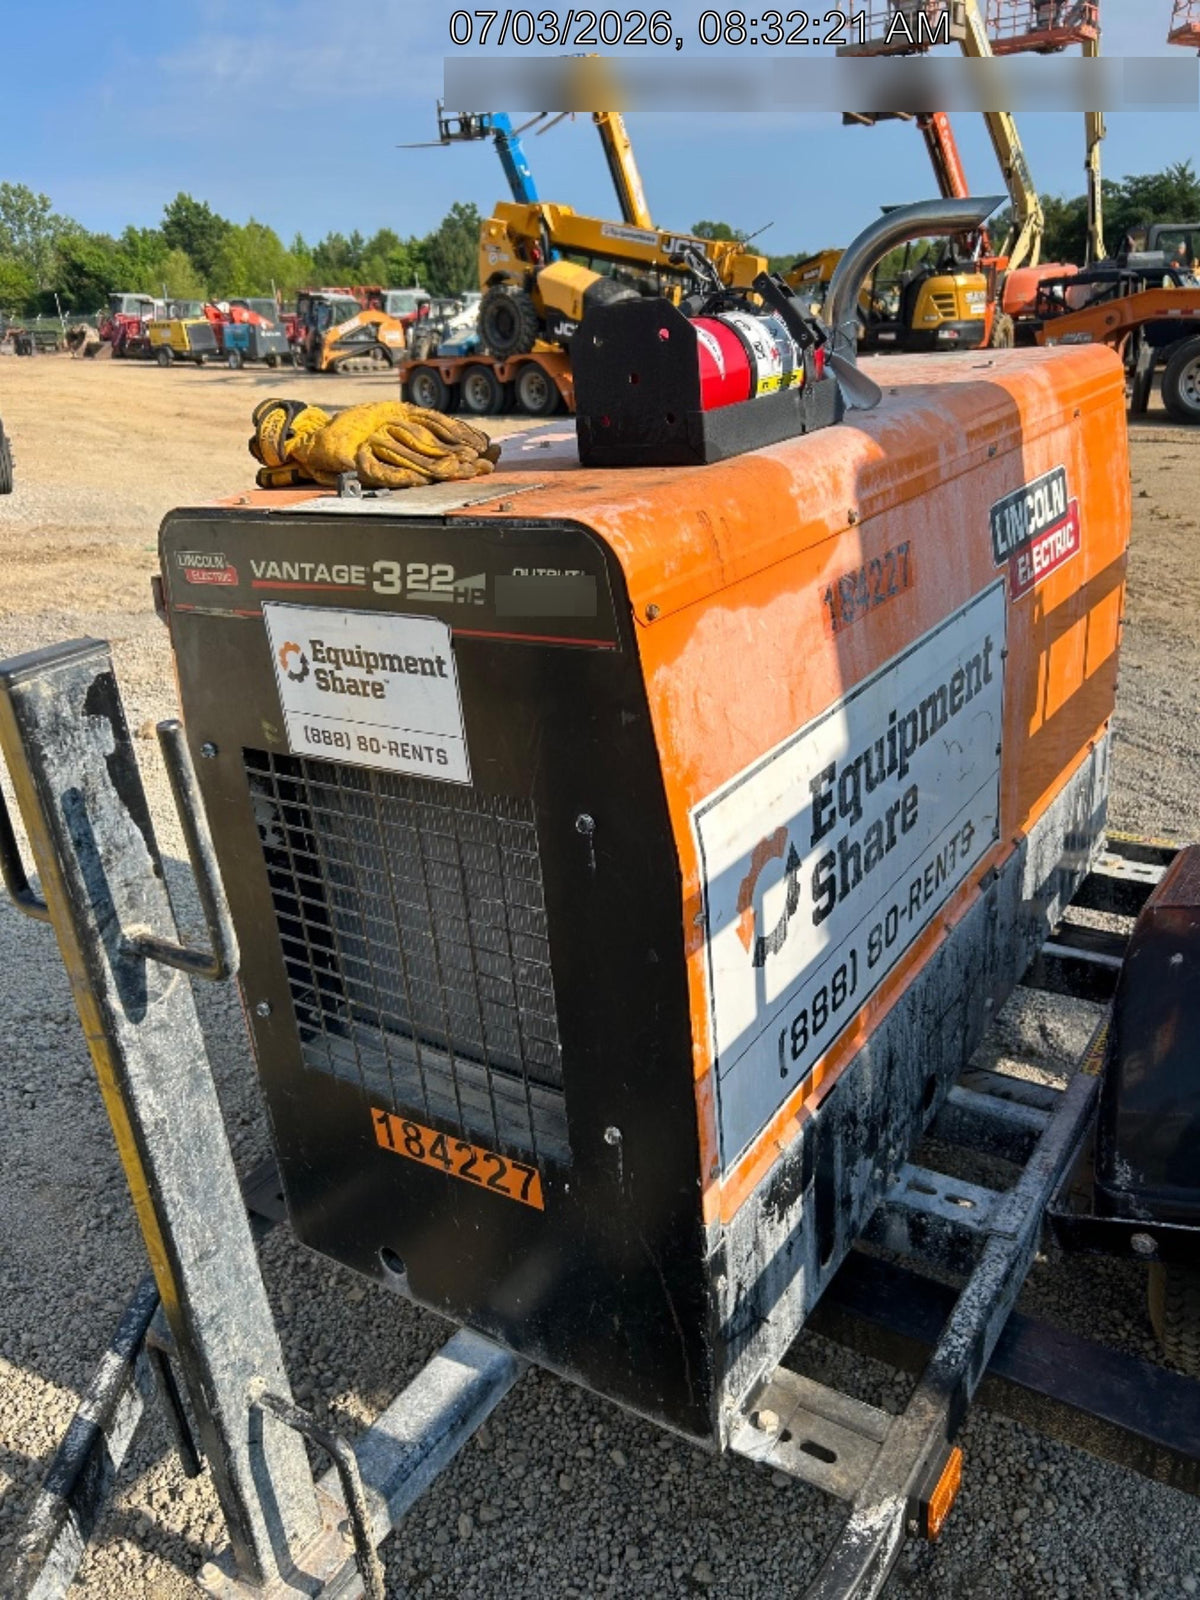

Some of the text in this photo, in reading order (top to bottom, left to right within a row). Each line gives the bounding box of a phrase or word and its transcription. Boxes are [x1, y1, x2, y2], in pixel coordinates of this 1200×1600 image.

[994, 476, 1067, 556] LINCOLN
[177, 553, 224, 569] LINCOLN
[191, 570, 232, 582] ELECTRIC
[250, 560, 366, 585] VANTAGE
[824, 540, 910, 632] 184227
[1018, 521, 1076, 586] ELECTRIC
[309, 639, 449, 679] Equipment
[314, 668, 386, 699] Share
[304, 725, 449, 766] (888) 80-RENTS
[809, 634, 994, 849] Equipment
[812, 783, 919, 927] Share
[778, 819, 976, 1079] (888) 80-RENTS
[376, 1111, 536, 1201] 184227
